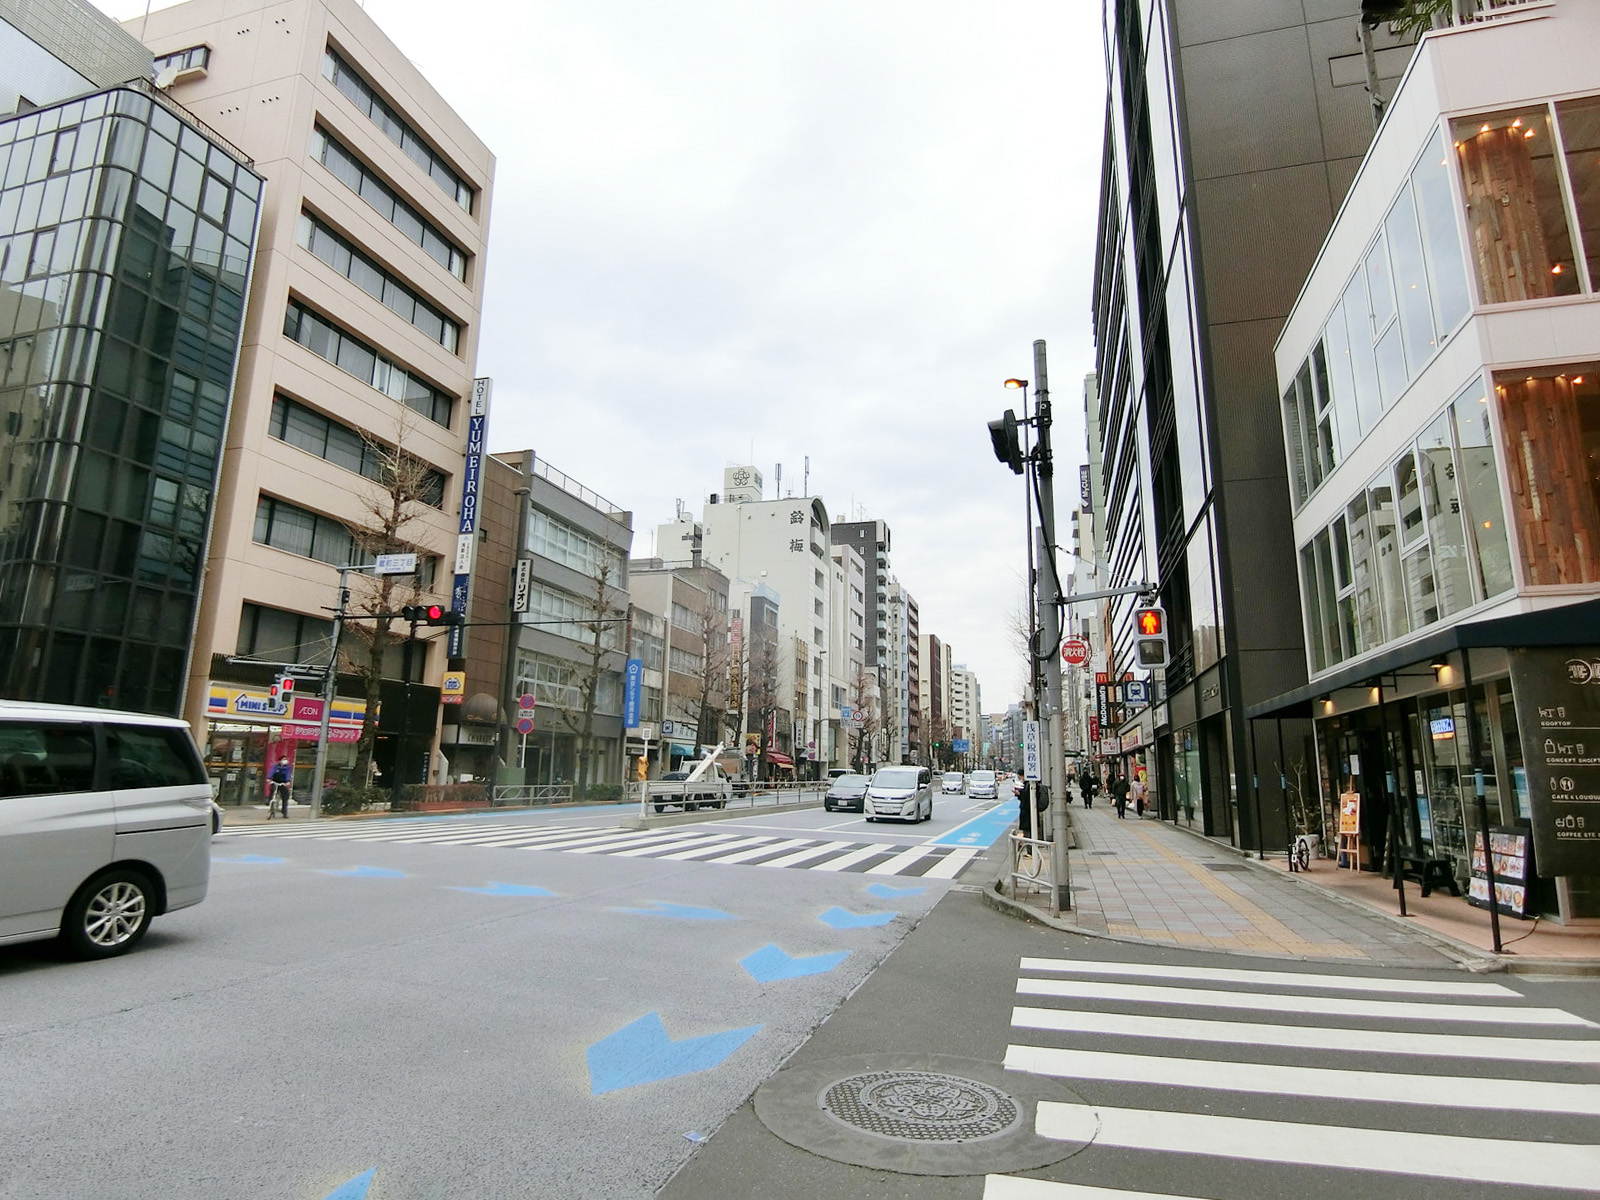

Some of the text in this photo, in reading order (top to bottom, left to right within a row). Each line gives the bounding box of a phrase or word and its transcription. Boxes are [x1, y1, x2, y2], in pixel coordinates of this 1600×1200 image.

[475, 380, 485, 415] HOTEL
[461, 417, 482, 532] YUMEIROHA
[1063, 646, 1085, 657] 消火栓
[240, 700, 284, 713] MINI SP
[1099, 685, 1108, 726] McDonald's
[1026, 723, 1037, 772] 浅草税務署
